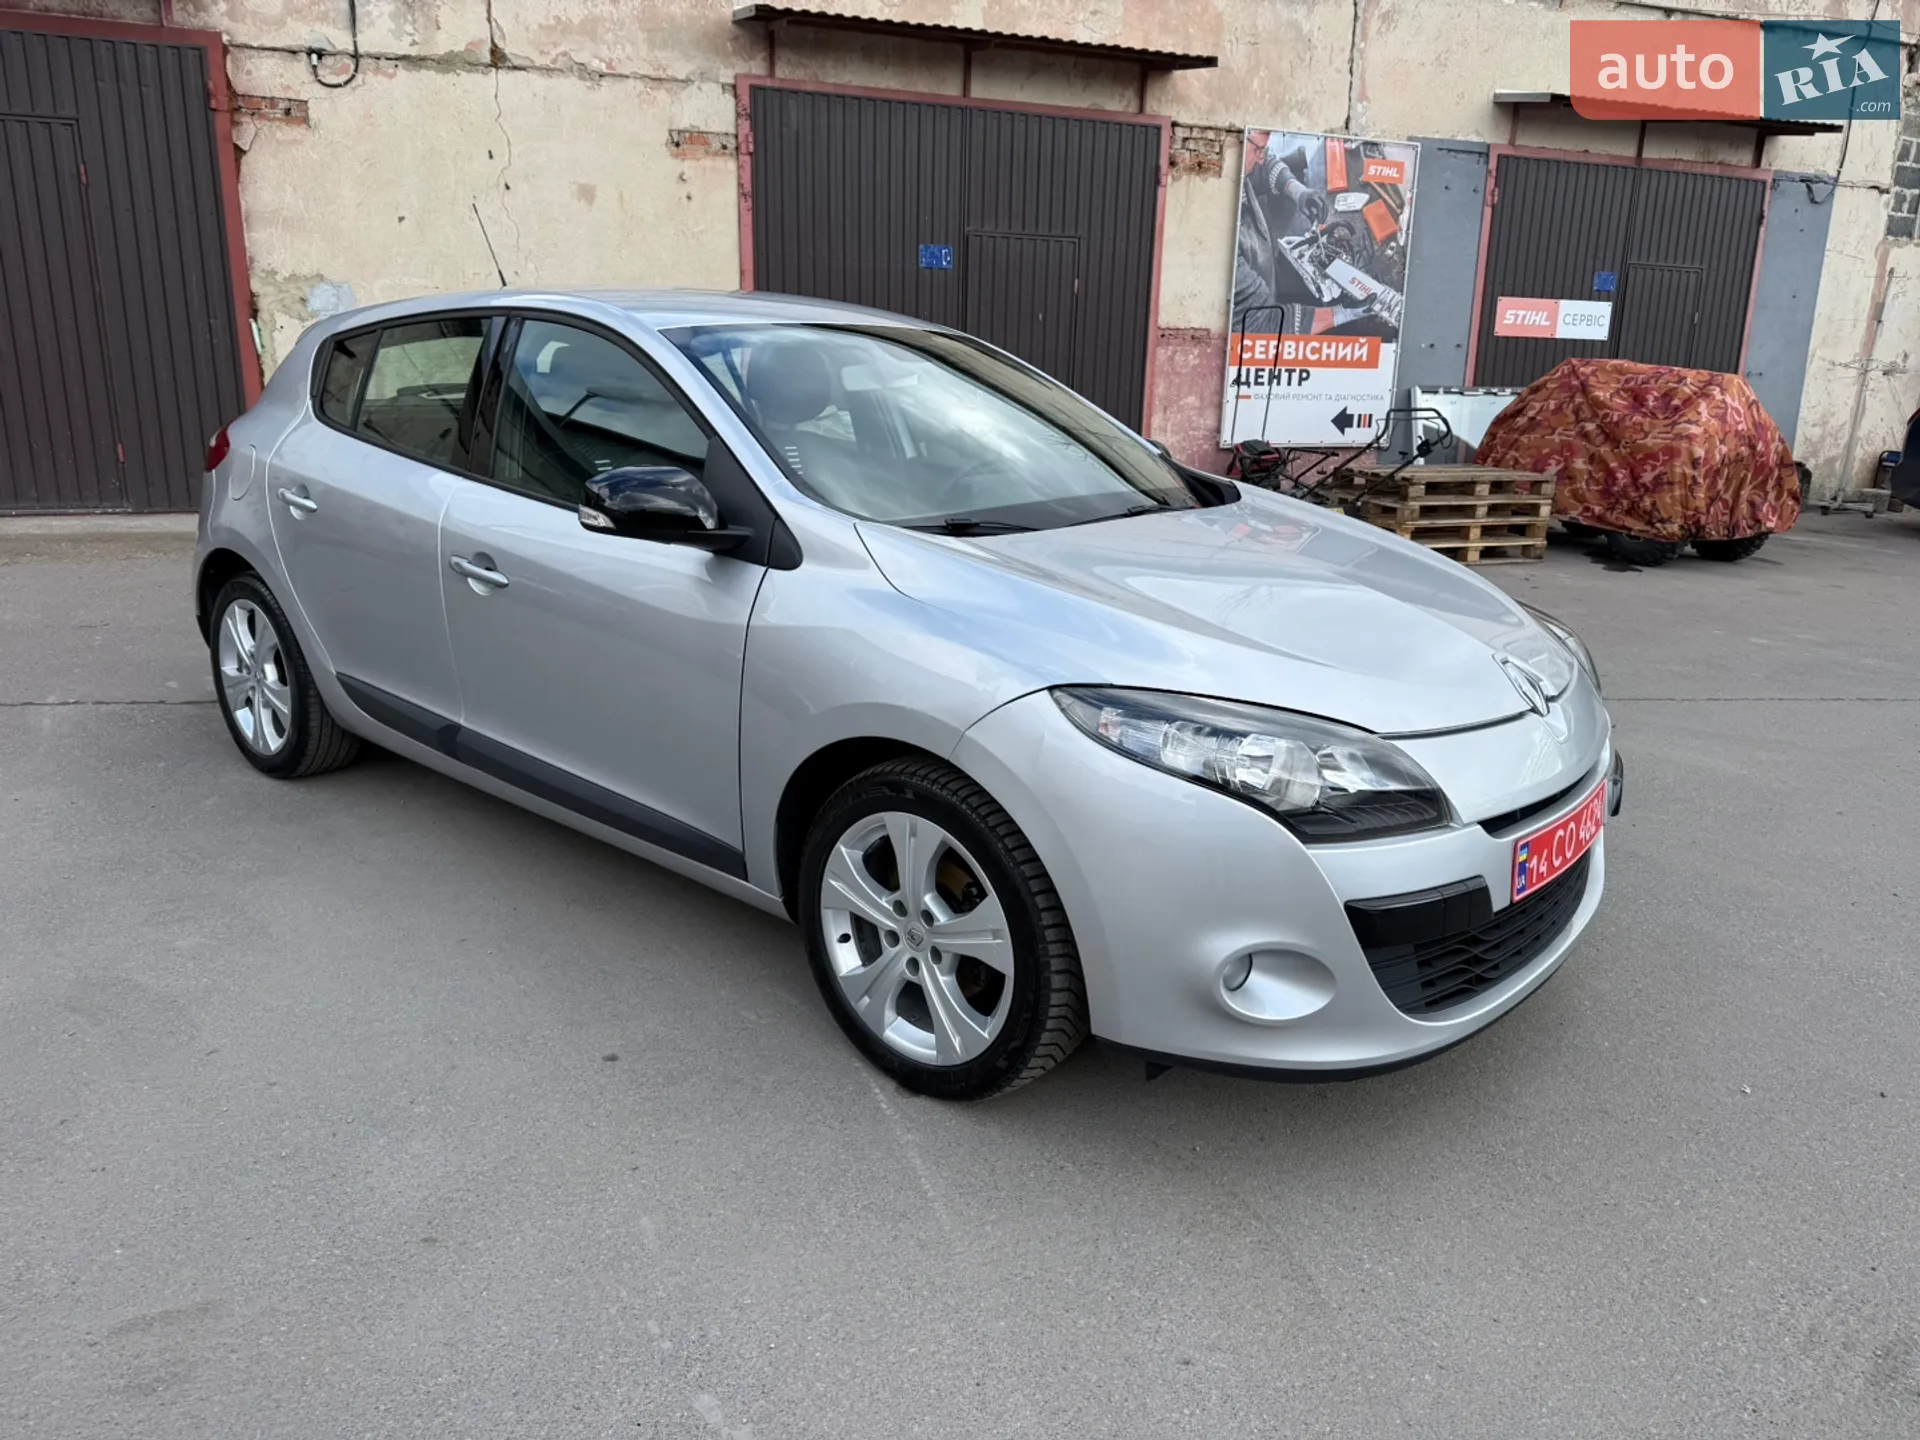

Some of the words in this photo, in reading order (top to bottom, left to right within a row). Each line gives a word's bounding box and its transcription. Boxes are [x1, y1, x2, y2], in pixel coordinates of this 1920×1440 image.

[1367, 165, 1400, 177] STIHL
[1503, 309, 1551, 326] STIHL
[1562, 313, 1606, 327] СЕРВІС
[1237, 338, 1368, 362] СЕРВІСНИЙ
[1237, 367, 1311, 388] ЦЕНТР
[1292, 393, 1322, 401] РЕМОНТ
[1324, 393, 1333, 401] ТА
[1334, 393, 1384, 402] ДІАГНОСТИКА
[1529, 848, 1548, 884] 14
[1552, 821, 1576, 868] CO
